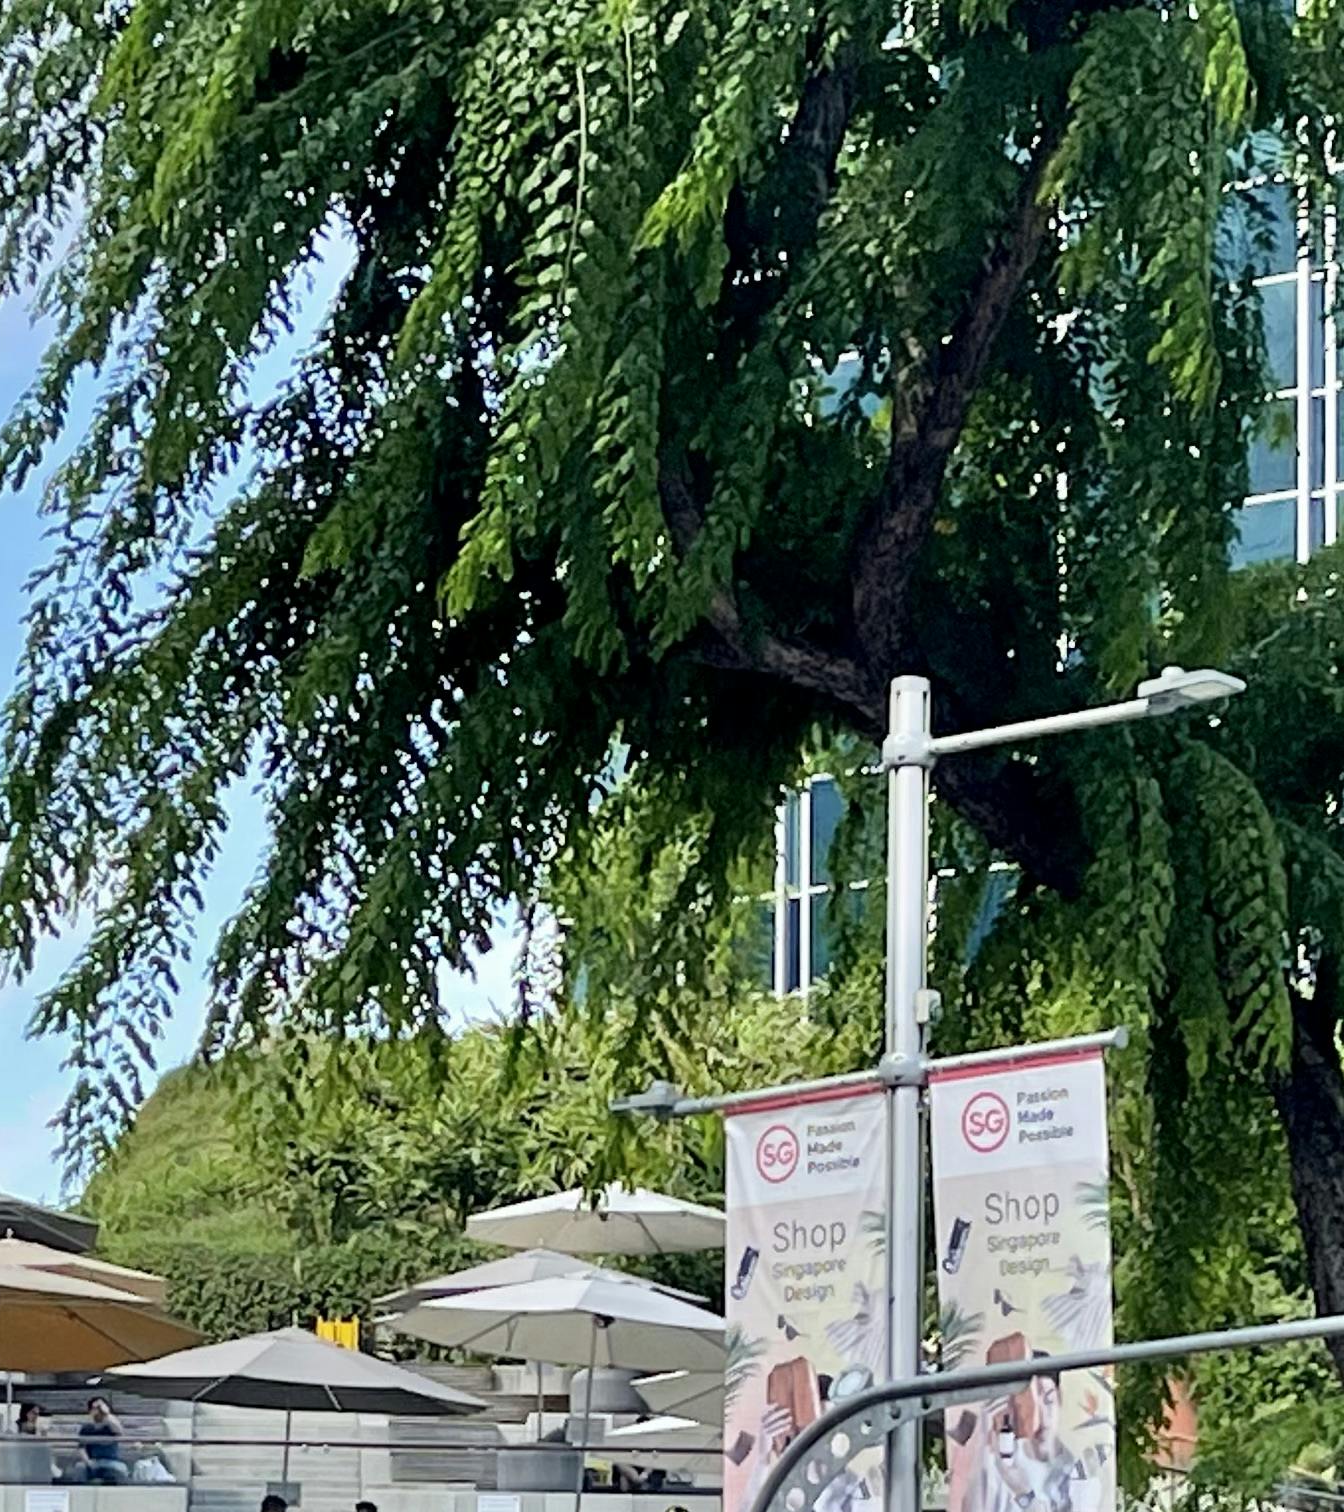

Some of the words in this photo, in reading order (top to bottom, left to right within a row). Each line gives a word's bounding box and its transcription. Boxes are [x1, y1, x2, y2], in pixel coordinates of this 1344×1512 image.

[969, 1109, 1004, 1137] SG
[763, 1141, 794, 1167] SG
[984, 1191, 1060, 1226] Shop
[773, 1219, 846, 1253] Shop
